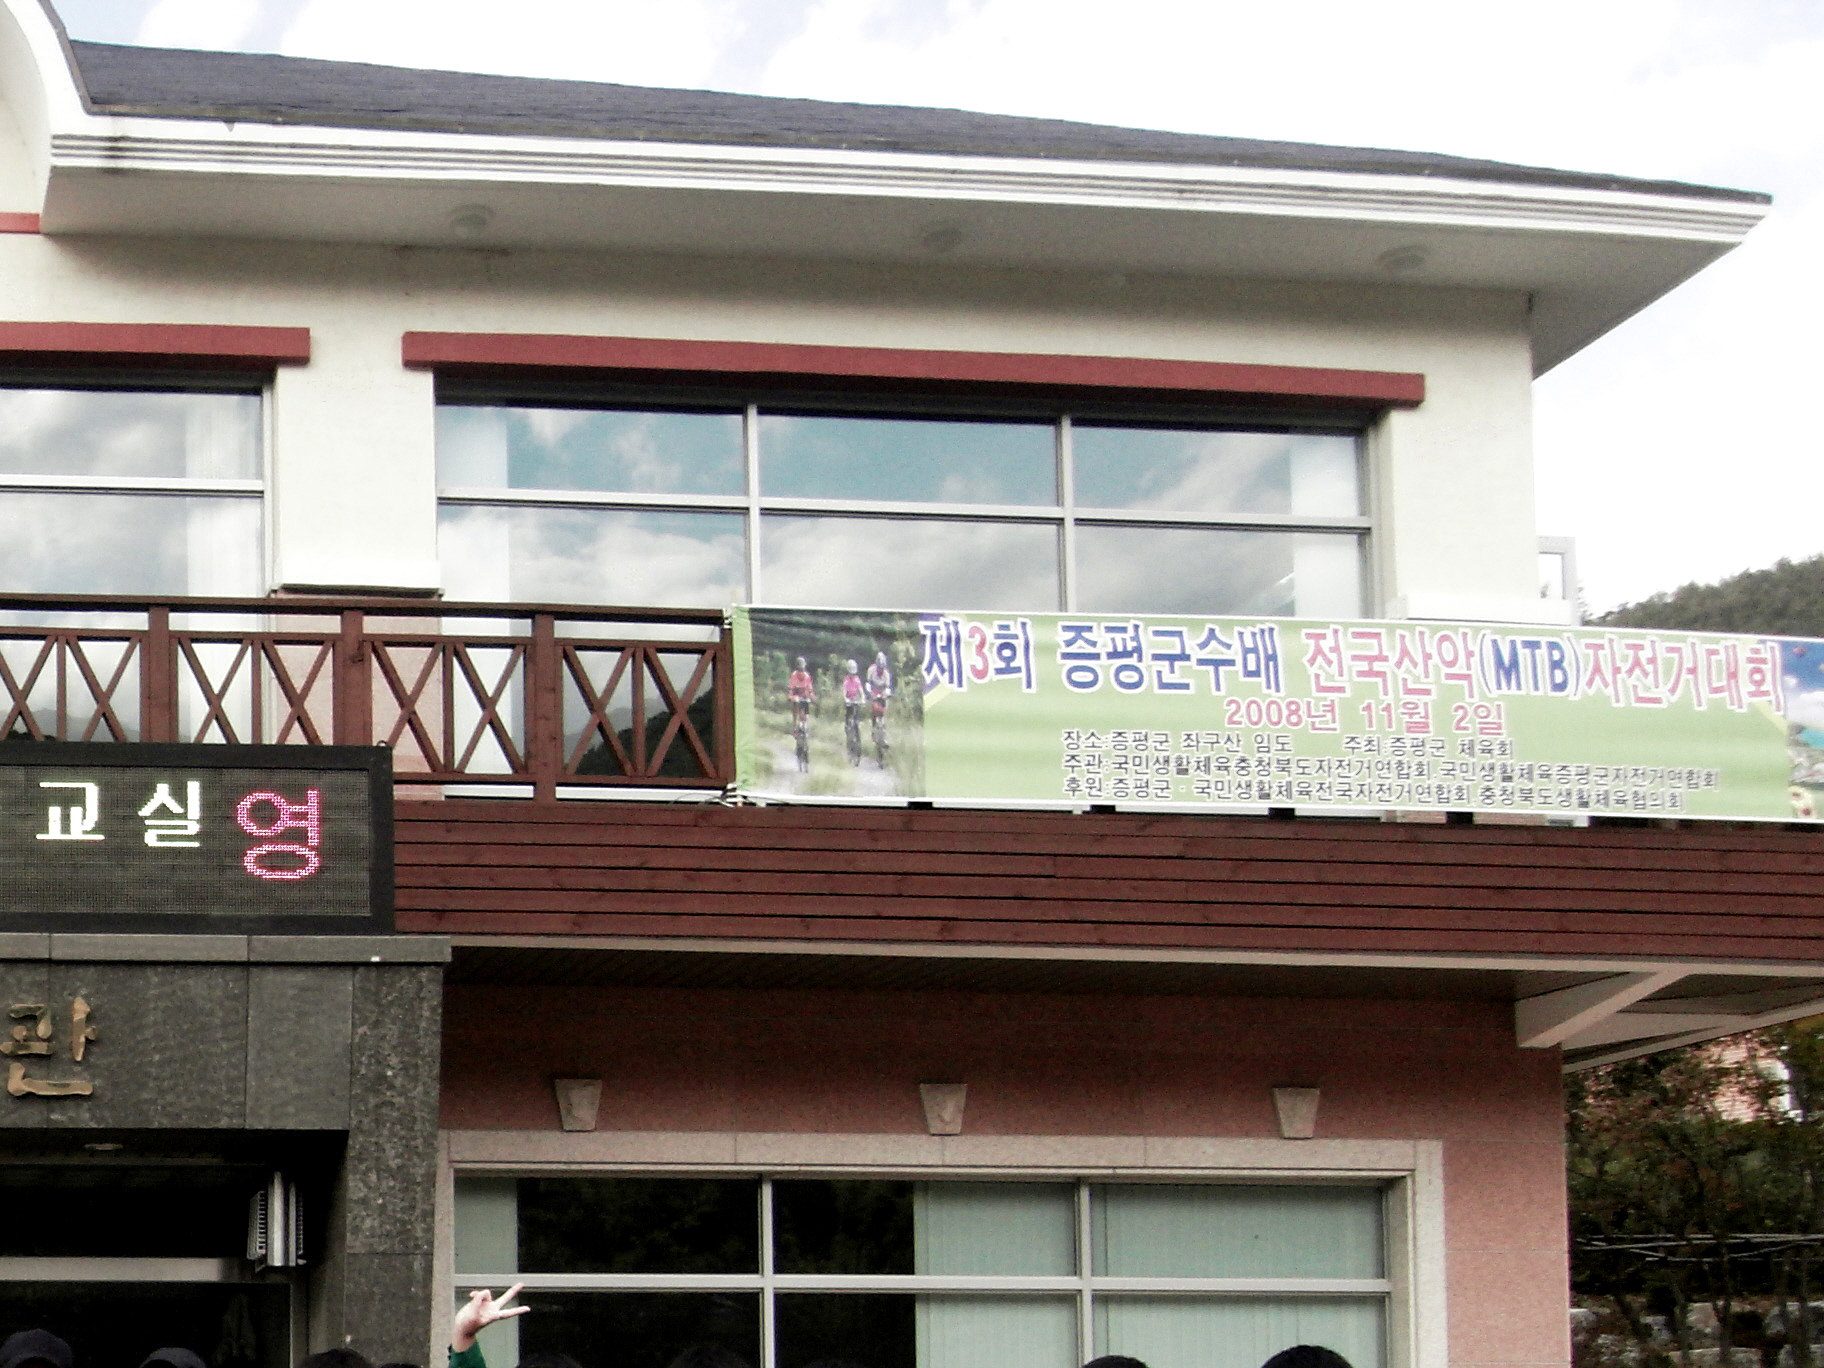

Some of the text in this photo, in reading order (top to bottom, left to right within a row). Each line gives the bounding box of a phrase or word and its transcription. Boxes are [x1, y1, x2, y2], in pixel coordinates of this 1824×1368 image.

[922, 618, 1033, 692] 제3회
[1058, 622, 1281, 693] 증평군수배
[1063, 730, 1170, 752] 장소:증평군
[1182, 732, 1242, 753] 좌구산
[1254, 733, 1293, 754] 임도
[1458, 738, 1514, 759] 체육회
[1225, 698, 1504, 736] 2008년 11월 2일
[235, 788, 321, 881] 영
